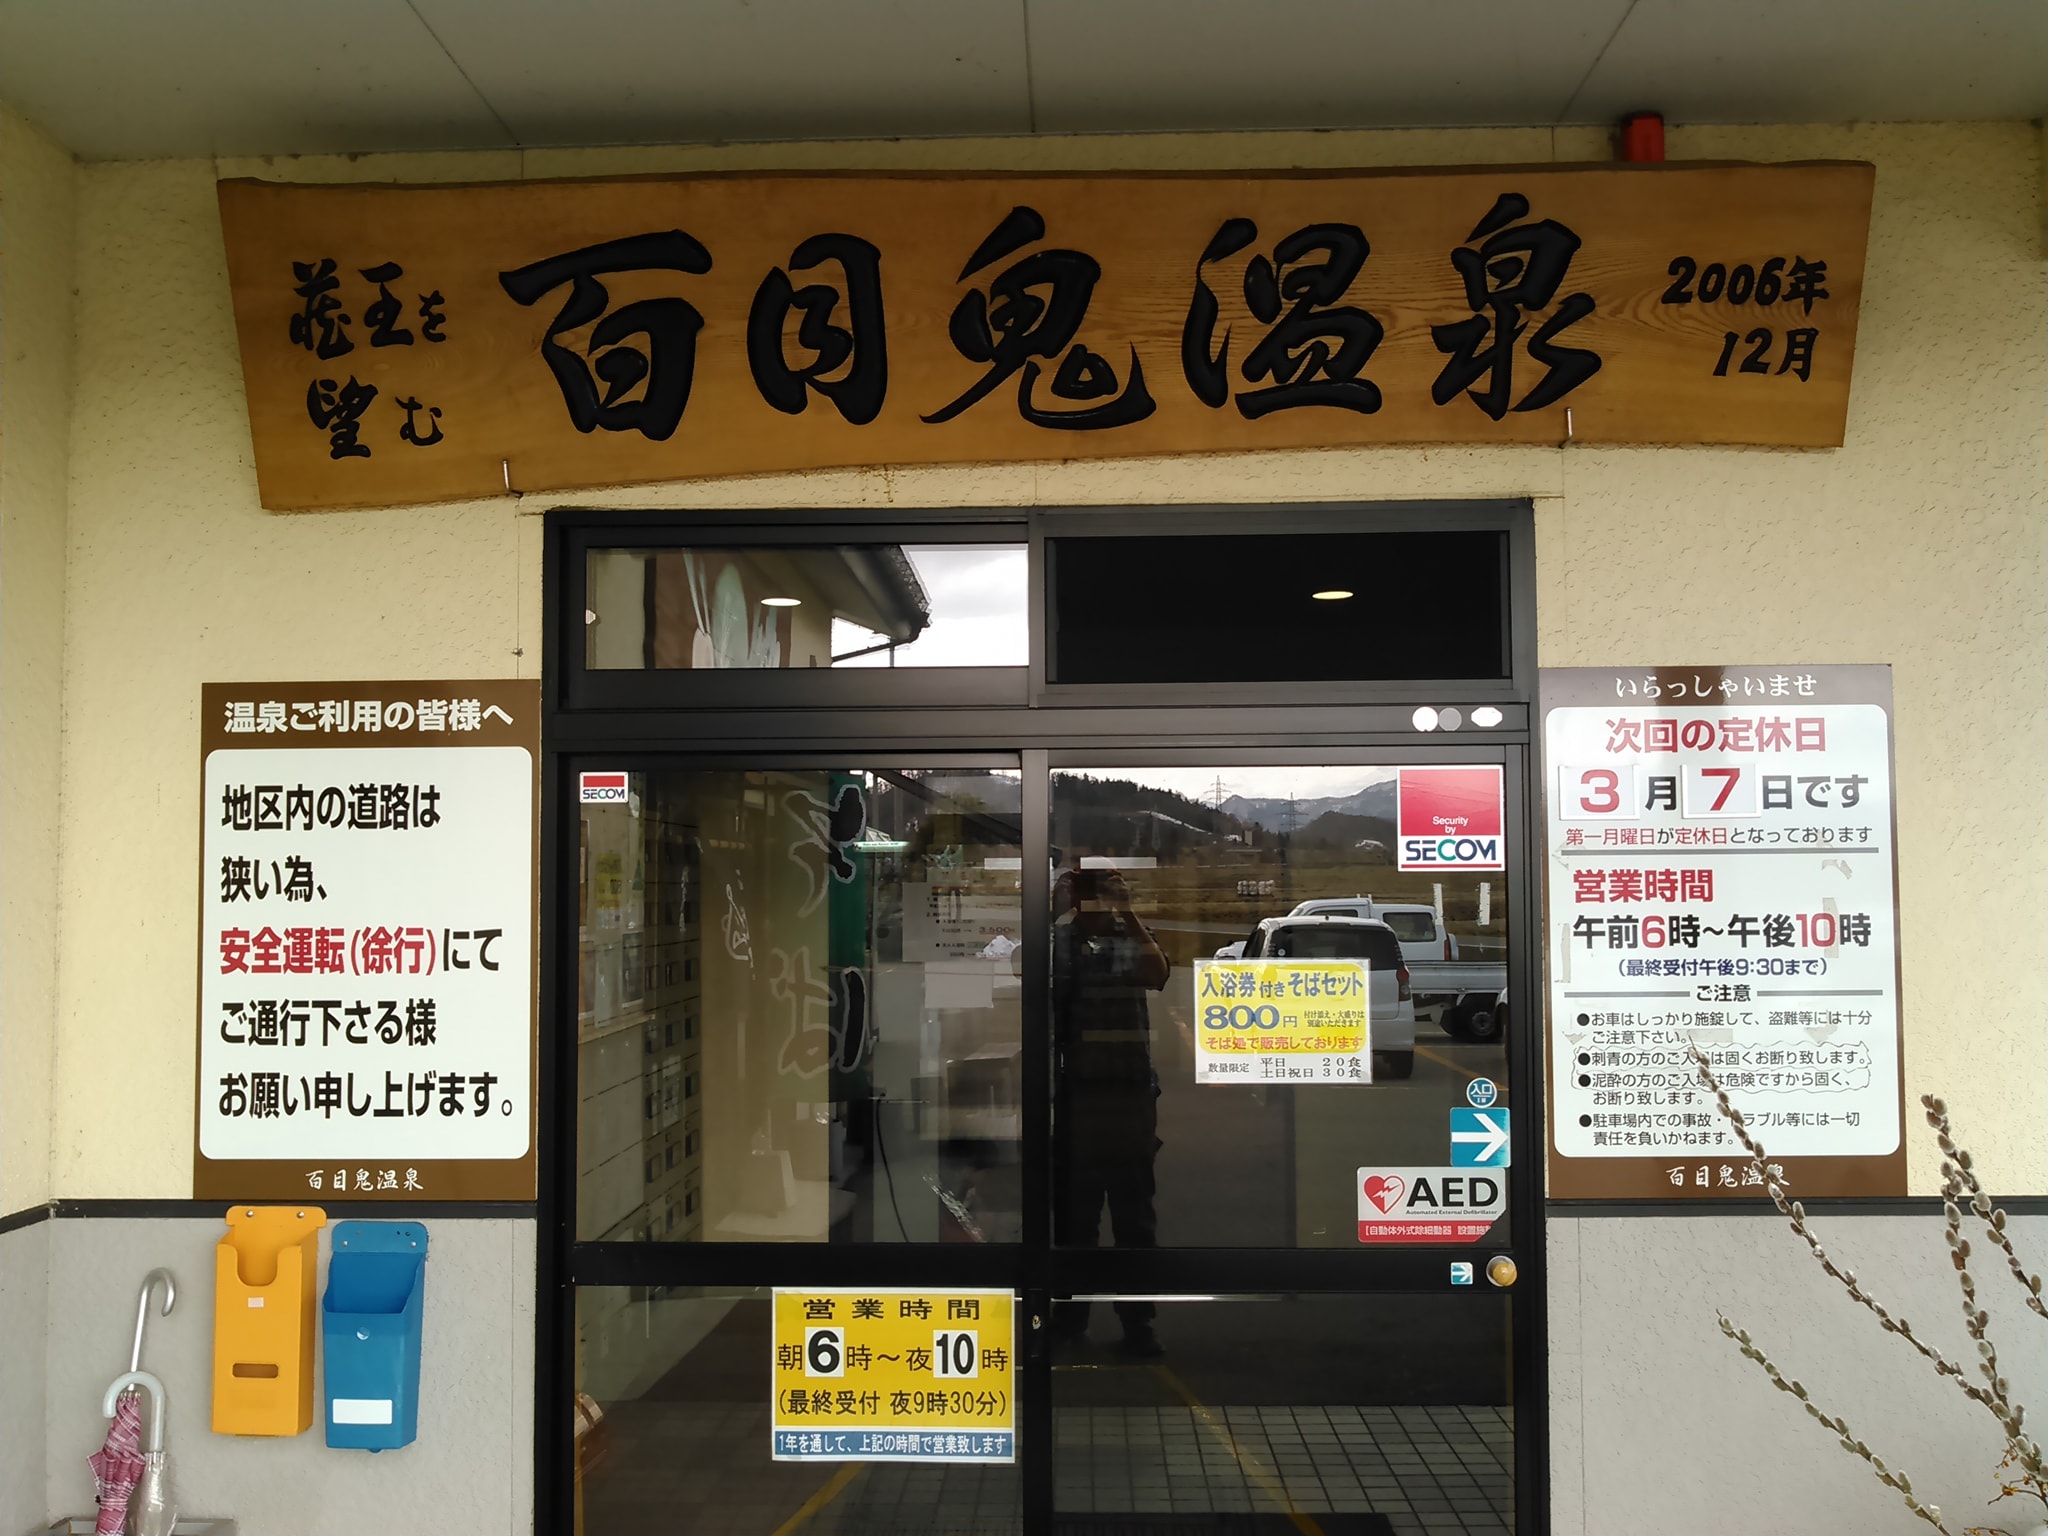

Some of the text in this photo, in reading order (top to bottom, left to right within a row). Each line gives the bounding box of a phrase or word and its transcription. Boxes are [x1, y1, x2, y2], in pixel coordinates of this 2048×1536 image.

[1661, 254, 1830, 317] 2006年
[498, 193, 1601, 441] 百目鬼温泉
[1713, 326, 1819, 383] 12月
[306, 374, 445, 460] 望む
[1615, 673, 1818, 699] いらっしゃいませ
[223, 699, 514, 733] 温泉ご利用の皆様へ
[1605, 716, 1826, 754] 次回の定休日
[582, 788, 625, 799] SECOM
[221, 782, 441, 831] 地区内の道路は
[1432, 816, 1469, 827] Security
[1445, 826, 1456, 835] by
[1565, 826, 1873, 846] 第一月曜日が定休日となっております
[1405, 838, 1497, 861] SECOM
[220, 855, 328, 903] 狭い為、
[1573, 868, 1714, 904] 営業時間
[219, 925, 503, 976] 安全運転(徐行)にて
[1696, 984, 1751, 1003] ご注意
[219, 998, 437, 1047] ご通行下さる様
[1203, 1005, 1298, 1030] 800円
[1205, 1036, 1363, 1050] そば処で販売しております
[1592, 1029, 1688, 1045] ご注意下さい。
[1208, 1062, 1250, 1073] 数量限定
[1591, 1050, 1867, 1067] 刺青の方のご入は固くお断り致します。
[218, 1070, 513, 1119] お願い申し上げます。
[1470, 1083, 1493, 1095] 入口
[1593, 1091, 1704, 1107] お断り致します。
[1592, 1112, 1861, 1129] 駐車場内での事故・ラブル等には一切
[1593, 1130, 1735, 1147] 責任を負いかねます。
[305, 1167, 424, 1192] 百目鬼温泉
[1406, 1177, 1499, 1207] AED
[803, 1298, 981, 1321] 営業時間
[779, 1390, 1007, 1416] (最終受付 夜9時30分)
[778, 1433, 1007, 1455] 1年を通して、上記の時間で営業致します
